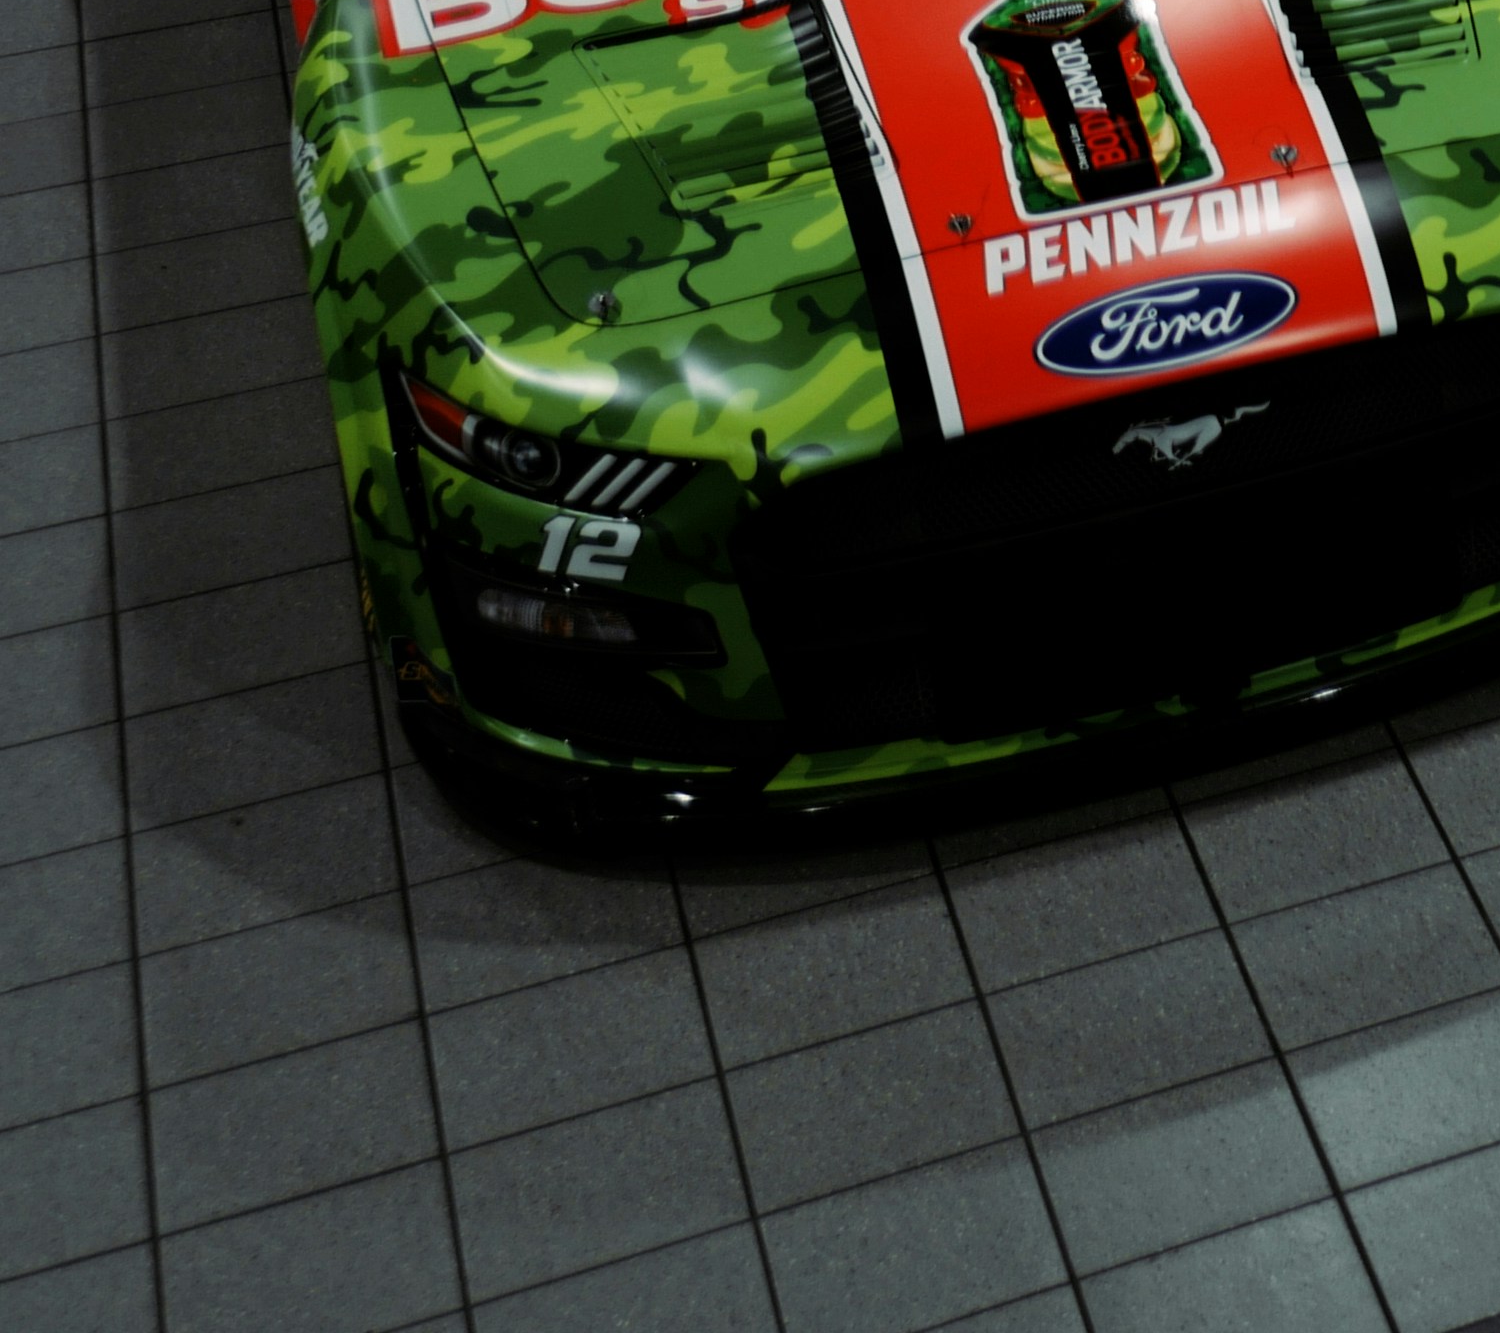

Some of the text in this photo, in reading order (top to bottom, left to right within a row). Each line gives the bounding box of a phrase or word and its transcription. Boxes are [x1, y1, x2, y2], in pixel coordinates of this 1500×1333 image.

[982, 177, 1300, 298] PENNZOIL
[1089, 283, 1245, 364] Ford
[535, 513, 645, 583] 12
